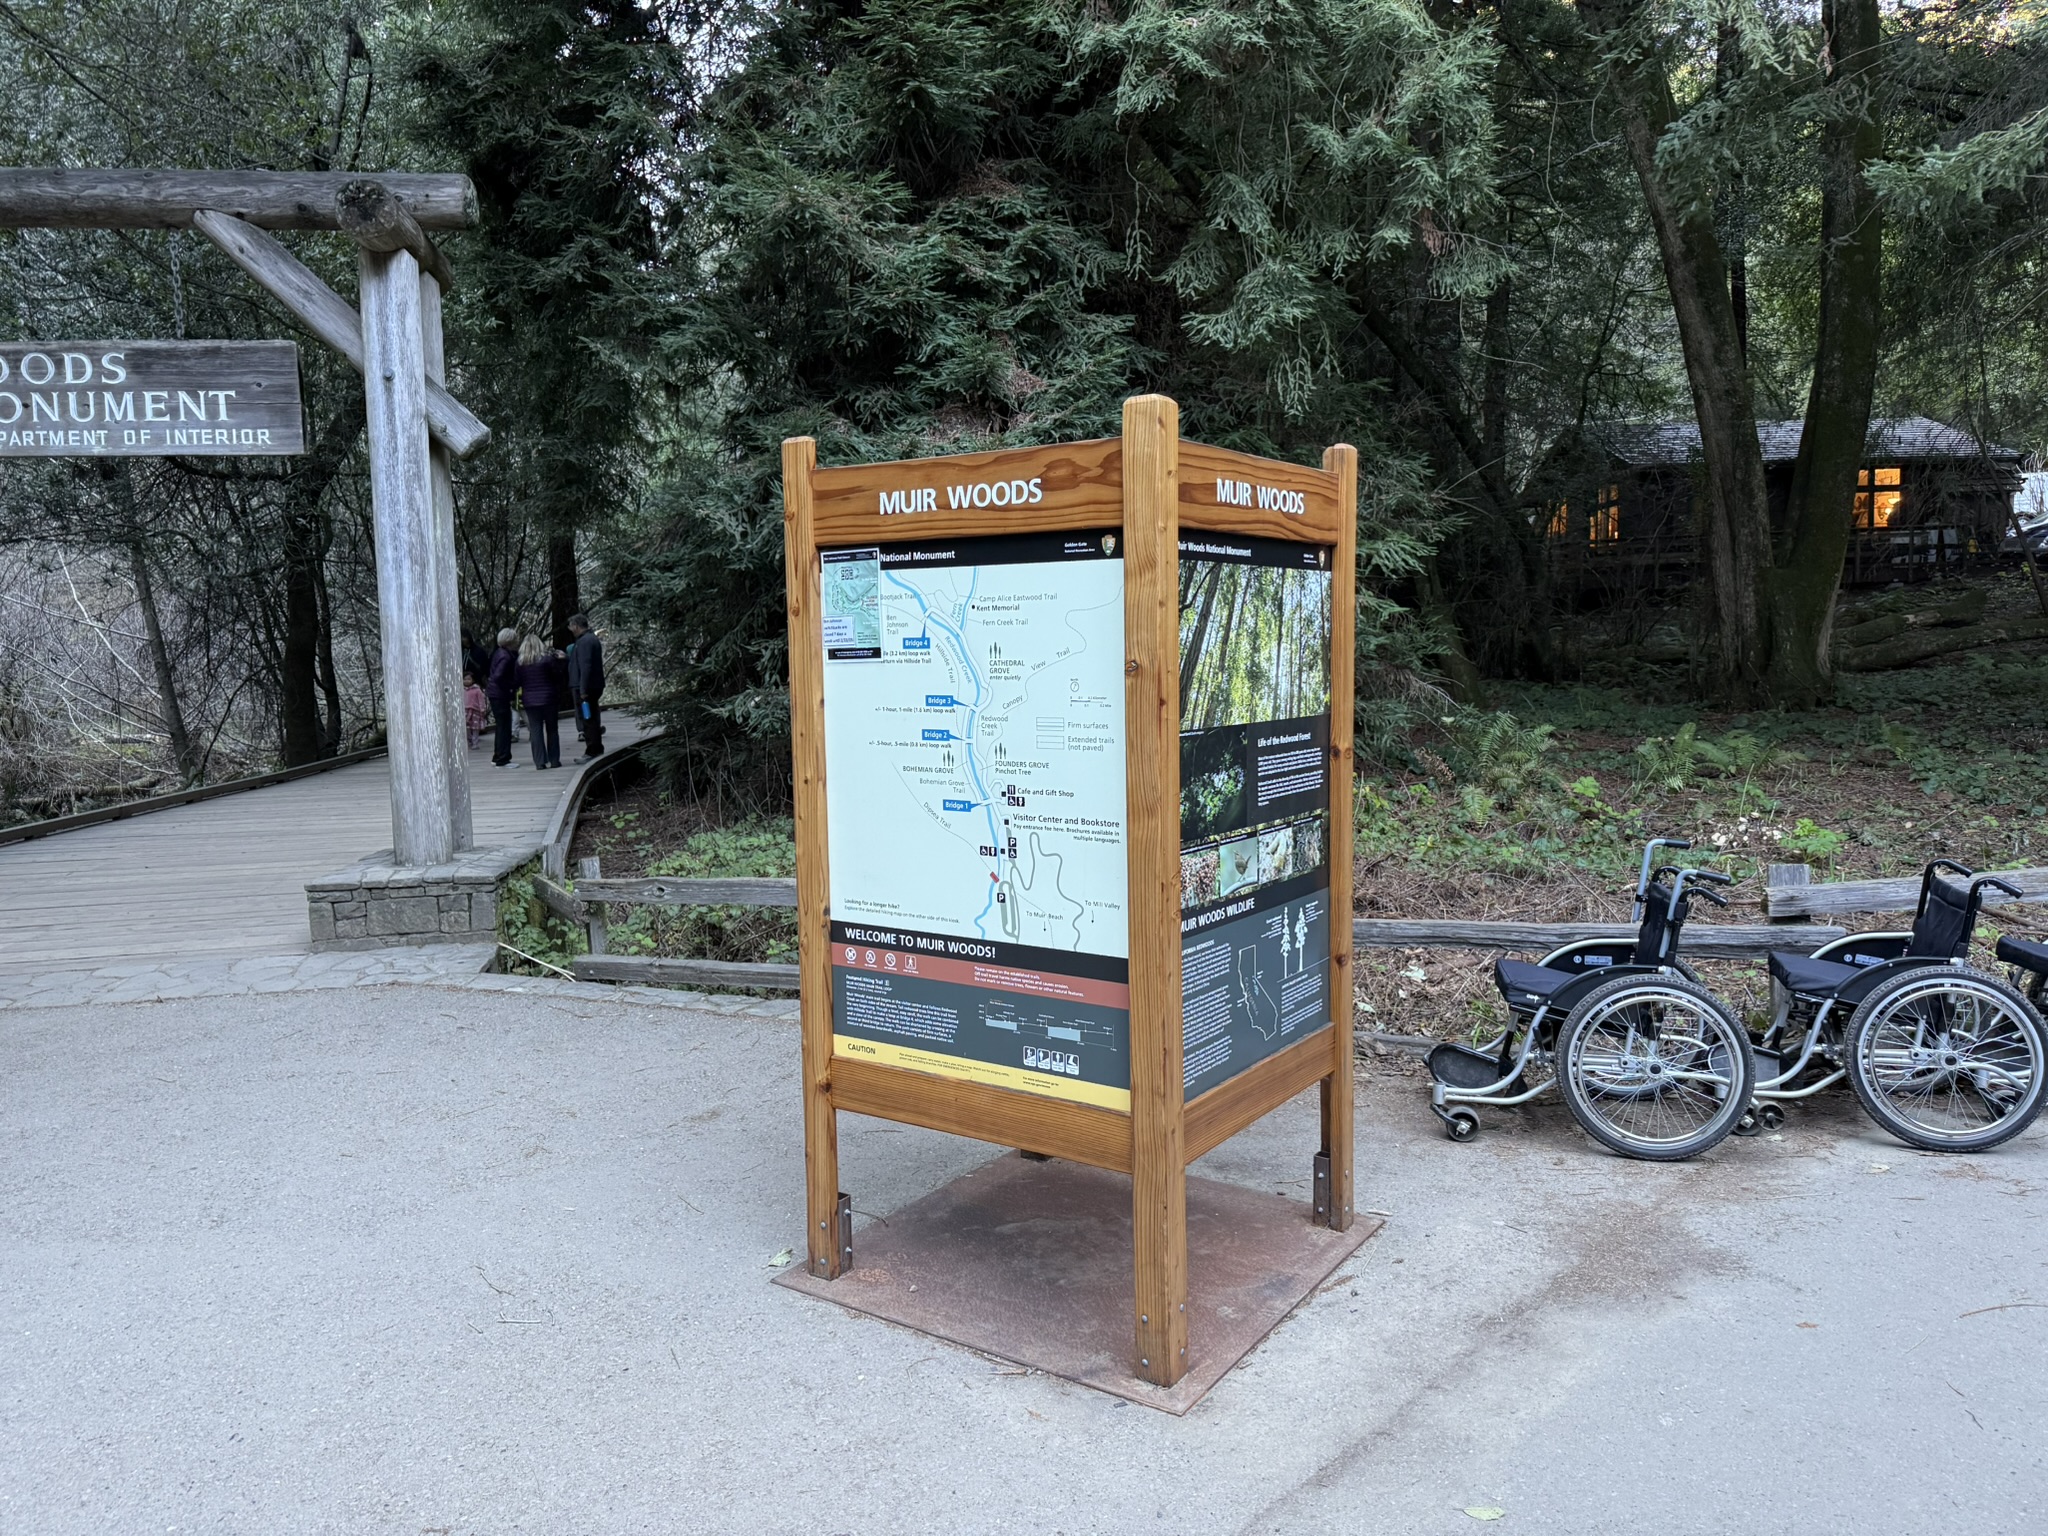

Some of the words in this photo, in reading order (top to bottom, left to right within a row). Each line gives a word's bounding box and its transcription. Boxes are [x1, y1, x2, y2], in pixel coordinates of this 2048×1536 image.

[0, 352, 126, 385] ODS
[124, 430, 151, 445] OF
[166, 429, 271, 445] INTERIOR
[879, 488, 937, 515] MUIR
[947, 478, 1042, 509] WOODS
[1217, 478, 1252, 507] MUIR
[1256, 485, 1305, 514] WOODS
[880, 552, 911, 562] National
[913, 550, 956, 561] Monument
[1188, 542, 1205, 553] Woods
[1206, 544, 1225, 554] National
[1226, 545, 1252, 557] Monument
[880, 593, 903, 601] Bootjack
[979, 595, 996, 603] Camp
[1013, 593, 1042, 601] Eastwood
[905, 640, 923, 648] Bridge
[935, 642, 950, 667] Hillside
[948, 667, 956, 684] Trail
[945, 636, 964, 665] Redwood
[961, 664, 972, 684] Creek
[1002, 695, 1023, 710] Canopy
[1031, 660, 1046, 672] View
[1056, 647, 1071, 659] Trail
[927, 697, 946, 705] Bridge
[924, 731, 942, 739] Bridge
[1257, 737, 1267, 747] Life
[1267, 737, 1272, 746] of
[1280, 733, 1299, 744] Redwood
[1299, 732, 1311, 742] Forest
[1067, 743, 1081, 751] (not
[1082, 744, 1104, 752] paved)
[1058, 790, 1074, 798] Shop
[945, 802, 963, 810] Bridge
[923, 801, 939, 820] Dipsea
[939, 817, 952, 829] Trail
[1012, 813, 1036, 822] Visitor
[1038, 815, 1062, 823] Center
[1064, 817, 1079, 825] and
[1081, 818, 1120, 828] Bookstore
[1104, 902, 1120, 910] Valley
[1198, 907, 1226, 927] WOODS
[1226, 897, 1255, 917] WILDLIFE
[844, 927, 897, 945] WELCOME
[899, 935, 914, 947] TO
[916, 937, 945, 952] MUIR
[947, 941, 996, 959] WOODS!
[847, 1043, 876, 1055] CAUTION
